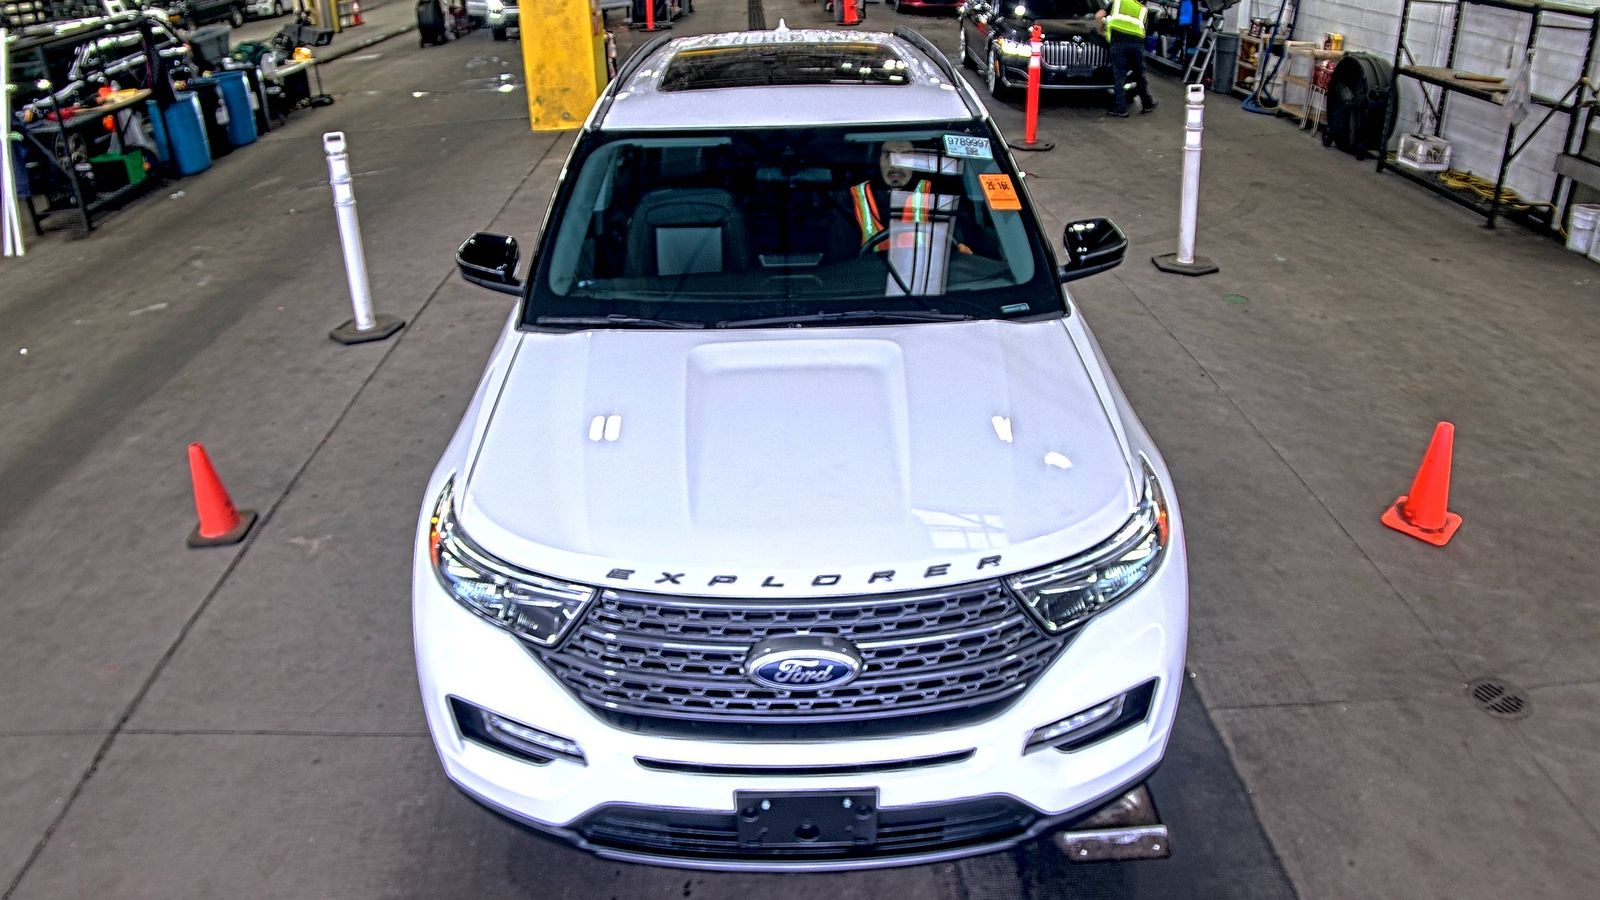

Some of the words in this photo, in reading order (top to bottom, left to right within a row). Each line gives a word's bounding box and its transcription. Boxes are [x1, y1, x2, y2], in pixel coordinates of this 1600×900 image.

[947, 137, 989, 148] 9789997
[606, 554, 1003, 588] EXPLORER
[773, 659, 834, 683] Ford
